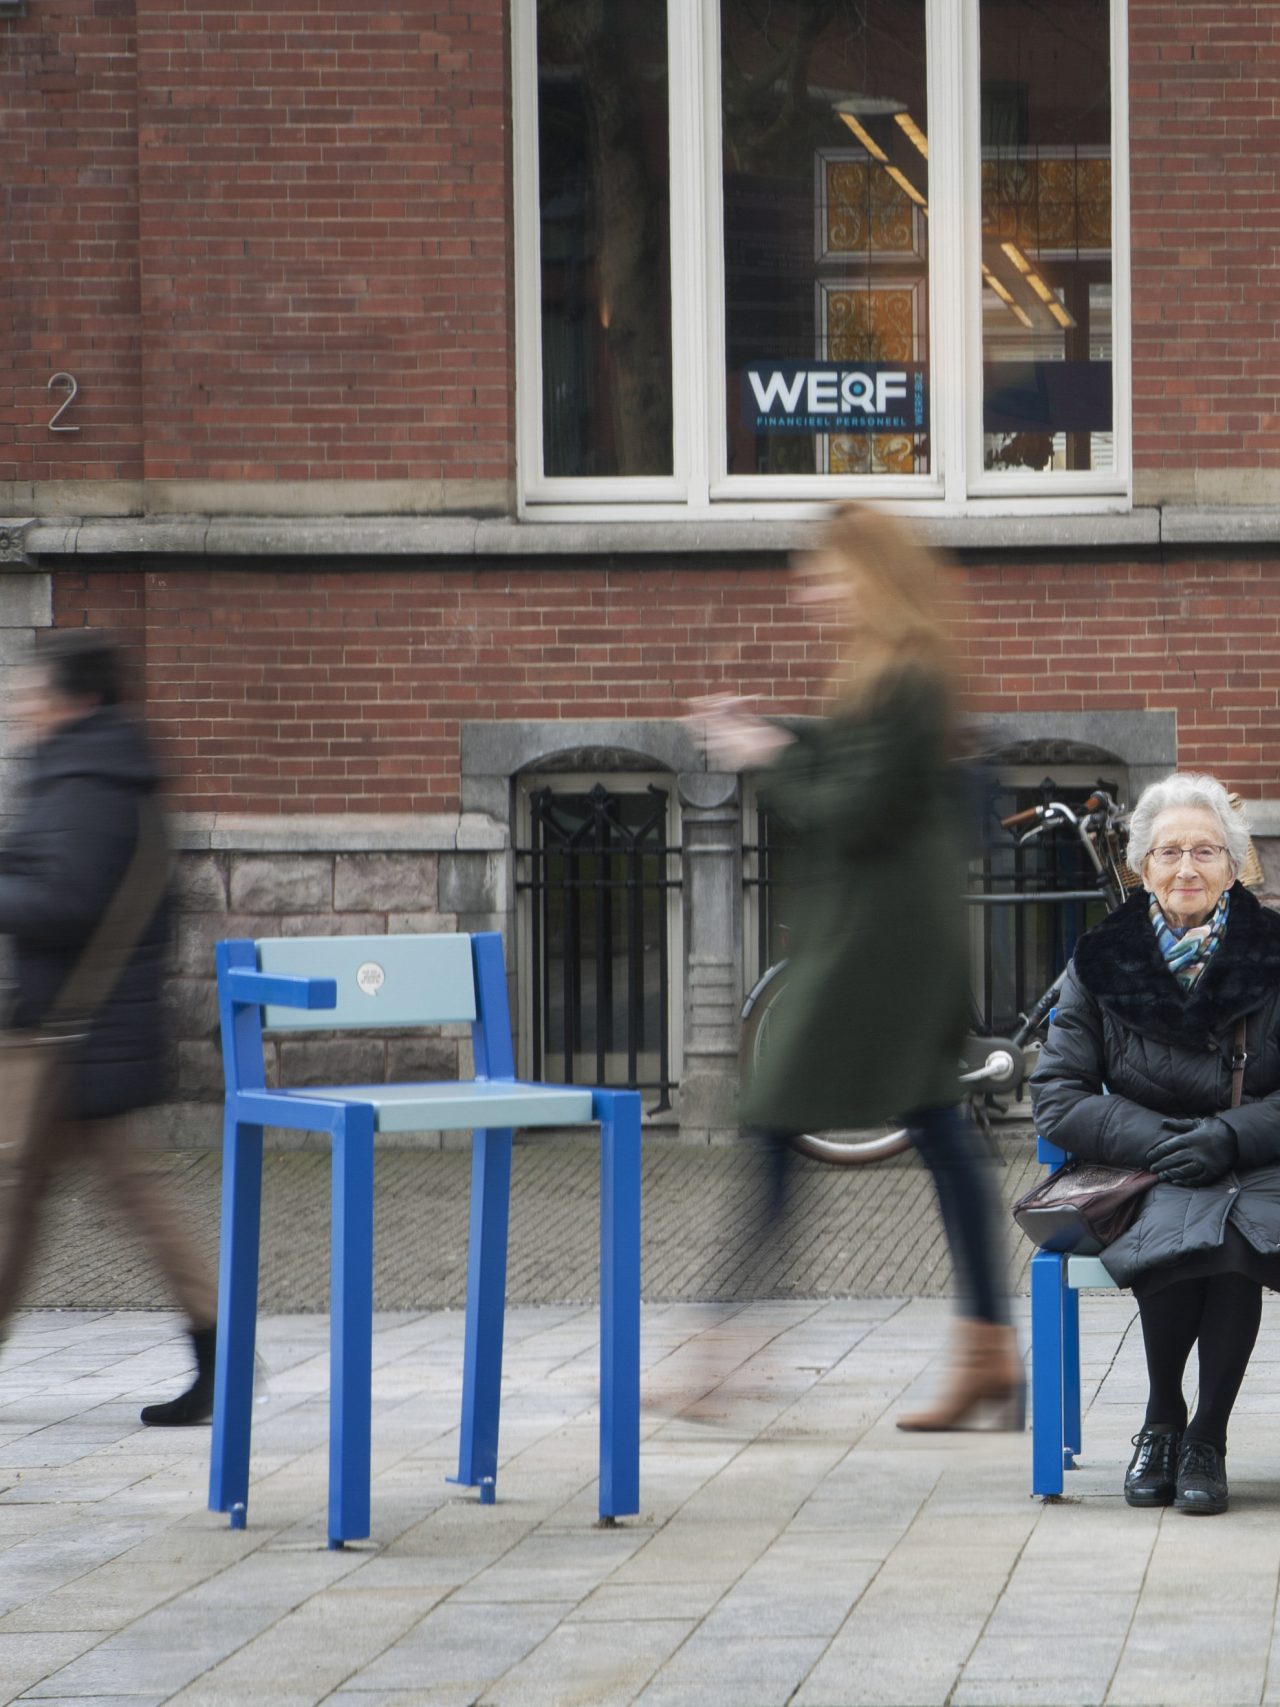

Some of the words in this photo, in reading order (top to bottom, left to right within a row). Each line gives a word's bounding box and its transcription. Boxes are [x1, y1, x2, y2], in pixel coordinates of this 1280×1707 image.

[48, 372, 80, 430] 2
[748, 371, 907, 413] WERF
[757, 416, 830, 426] FINANCIEEL
[836, 416, 906, 426] PERSONEEL
